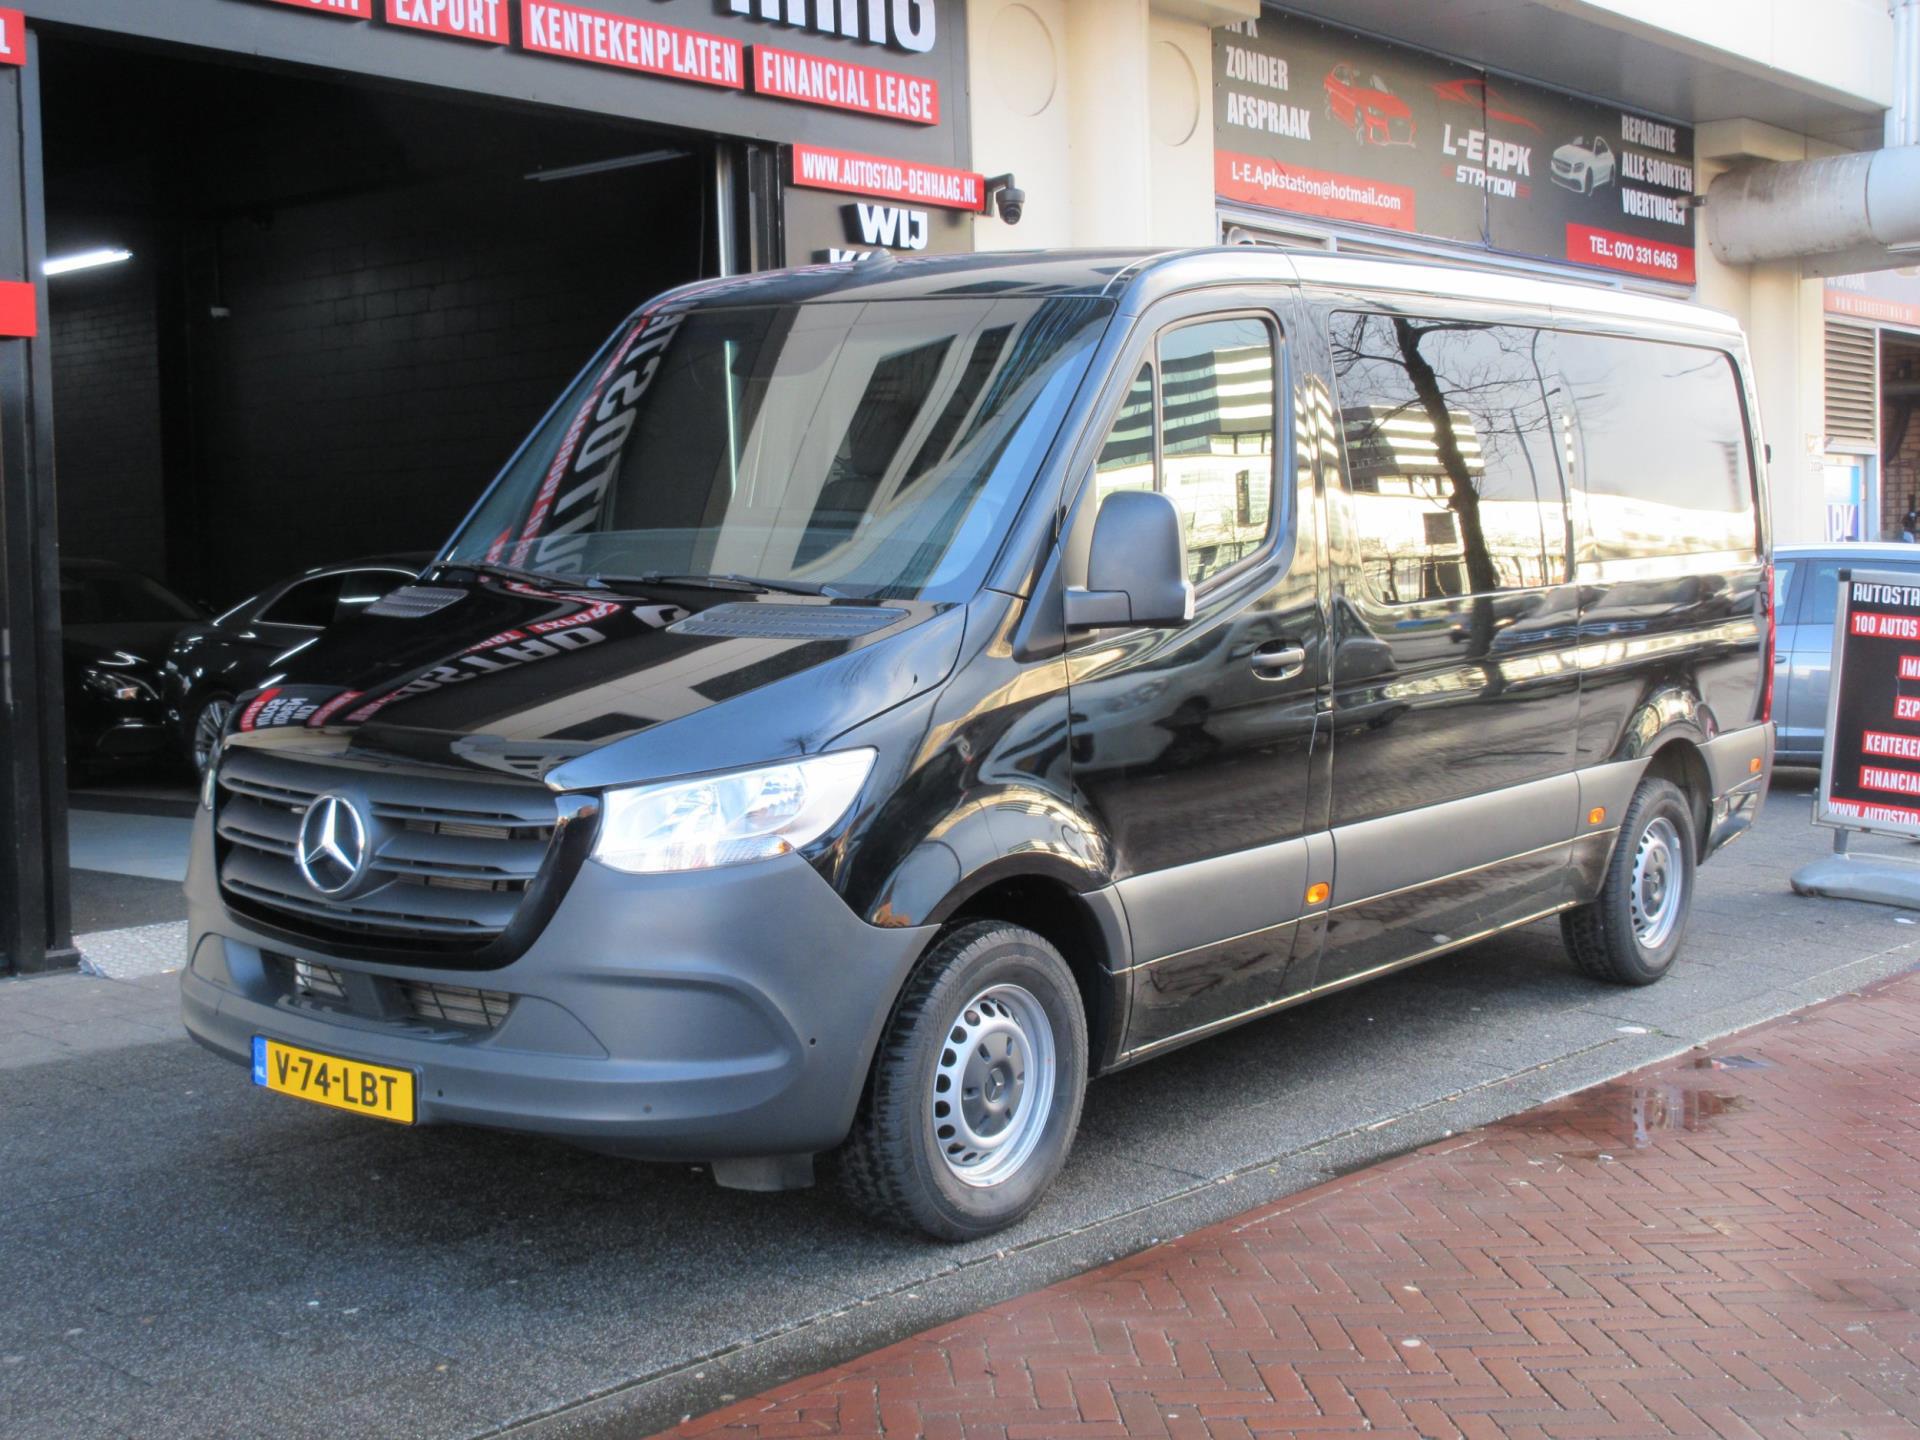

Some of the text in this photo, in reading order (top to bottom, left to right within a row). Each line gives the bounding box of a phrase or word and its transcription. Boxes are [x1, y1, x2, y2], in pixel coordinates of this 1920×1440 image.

[395, 0, 500, 37] EXPORT
[529, 3, 738, 83] KENTEKENPLATEN
[762, 51, 933, 120] FINANCIAL LEASE
[1225, 46, 1289, 91] ZONDER
[1227, 91, 1311, 141] AFSPRAAK
[1621, 113, 1676, 153] REPARATIE
[1442, 123, 1532, 177] L-E APK
[1621, 151, 1693, 193] ALLE SOORTEN
[801, 151, 977, 204] WWW.AUTOSTAD-DENHAAG.NL
[1231, 160, 1402, 211] L-E.Apkstation@hotmail.com
[1455, 165, 1517, 199] STATION
[856, 202, 929, 250] WIJ
[1621, 187, 1686, 226] VOERTUIGEN
[1589, 234, 1679, 270] TEL: 070 331 6463
[1855, 614, 1918, 638] 100 AUTOS
[275, 1050, 397, 1111] V-74-LBT
